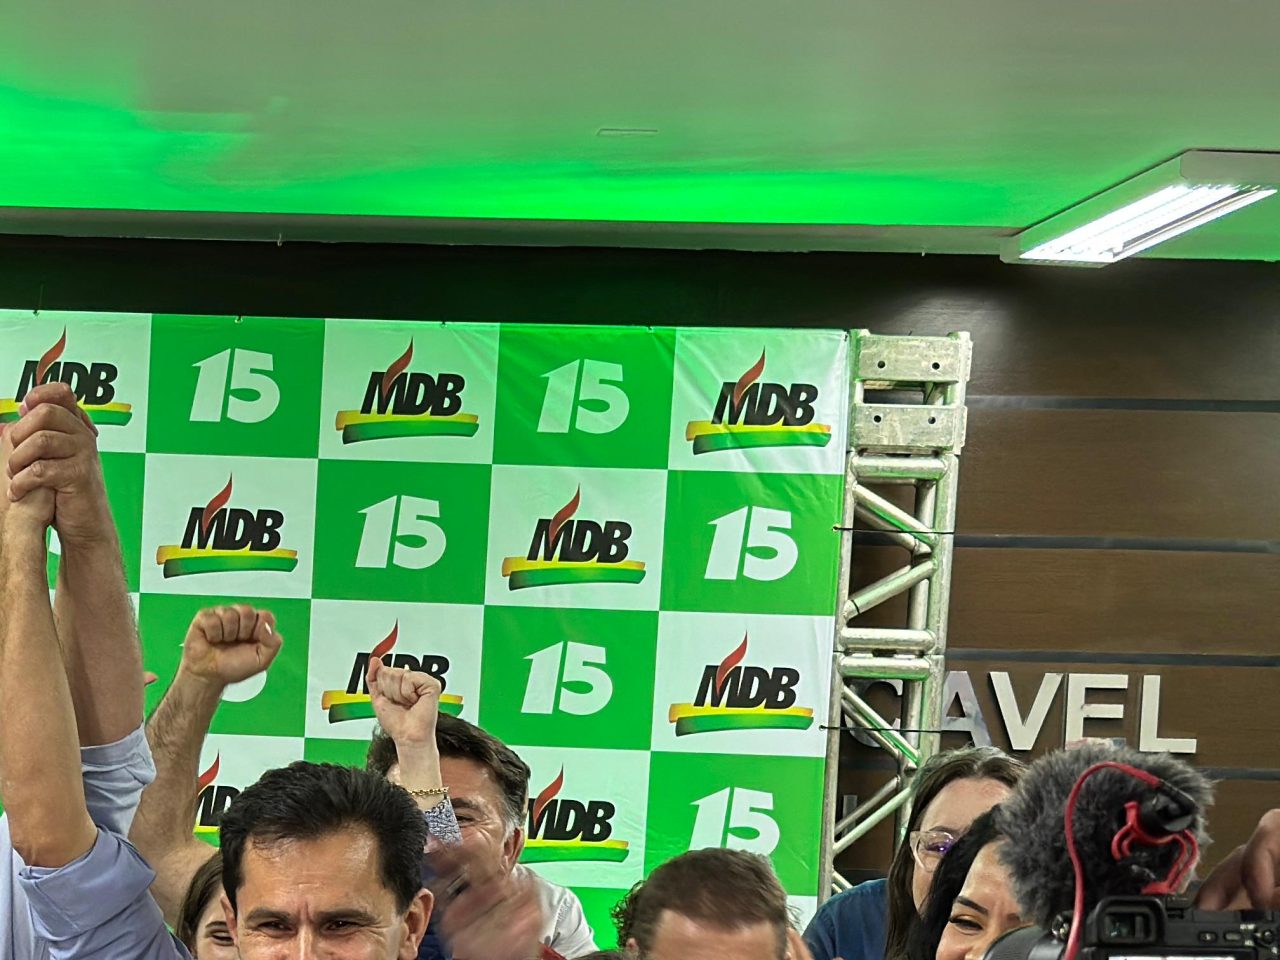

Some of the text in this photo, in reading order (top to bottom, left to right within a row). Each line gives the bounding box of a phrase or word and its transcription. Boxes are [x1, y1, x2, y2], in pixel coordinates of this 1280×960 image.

[190, 348, 280, 423] 15
[361, 371, 465, 417] MDB
[537, 359, 630, 434] 15
[713, 382, 818, 426] MDB
[180, 507, 284, 552] MDB
[355, 496, 447, 570] 15
[526, 519, 632, 564] MDB
[704, 506, 799, 581] 15
[521, 641, 613, 715] 15
[694, 665, 800, 710] MDB
[526, 798, 616, 843] MDB
[689, 787, 781, 854] 15
